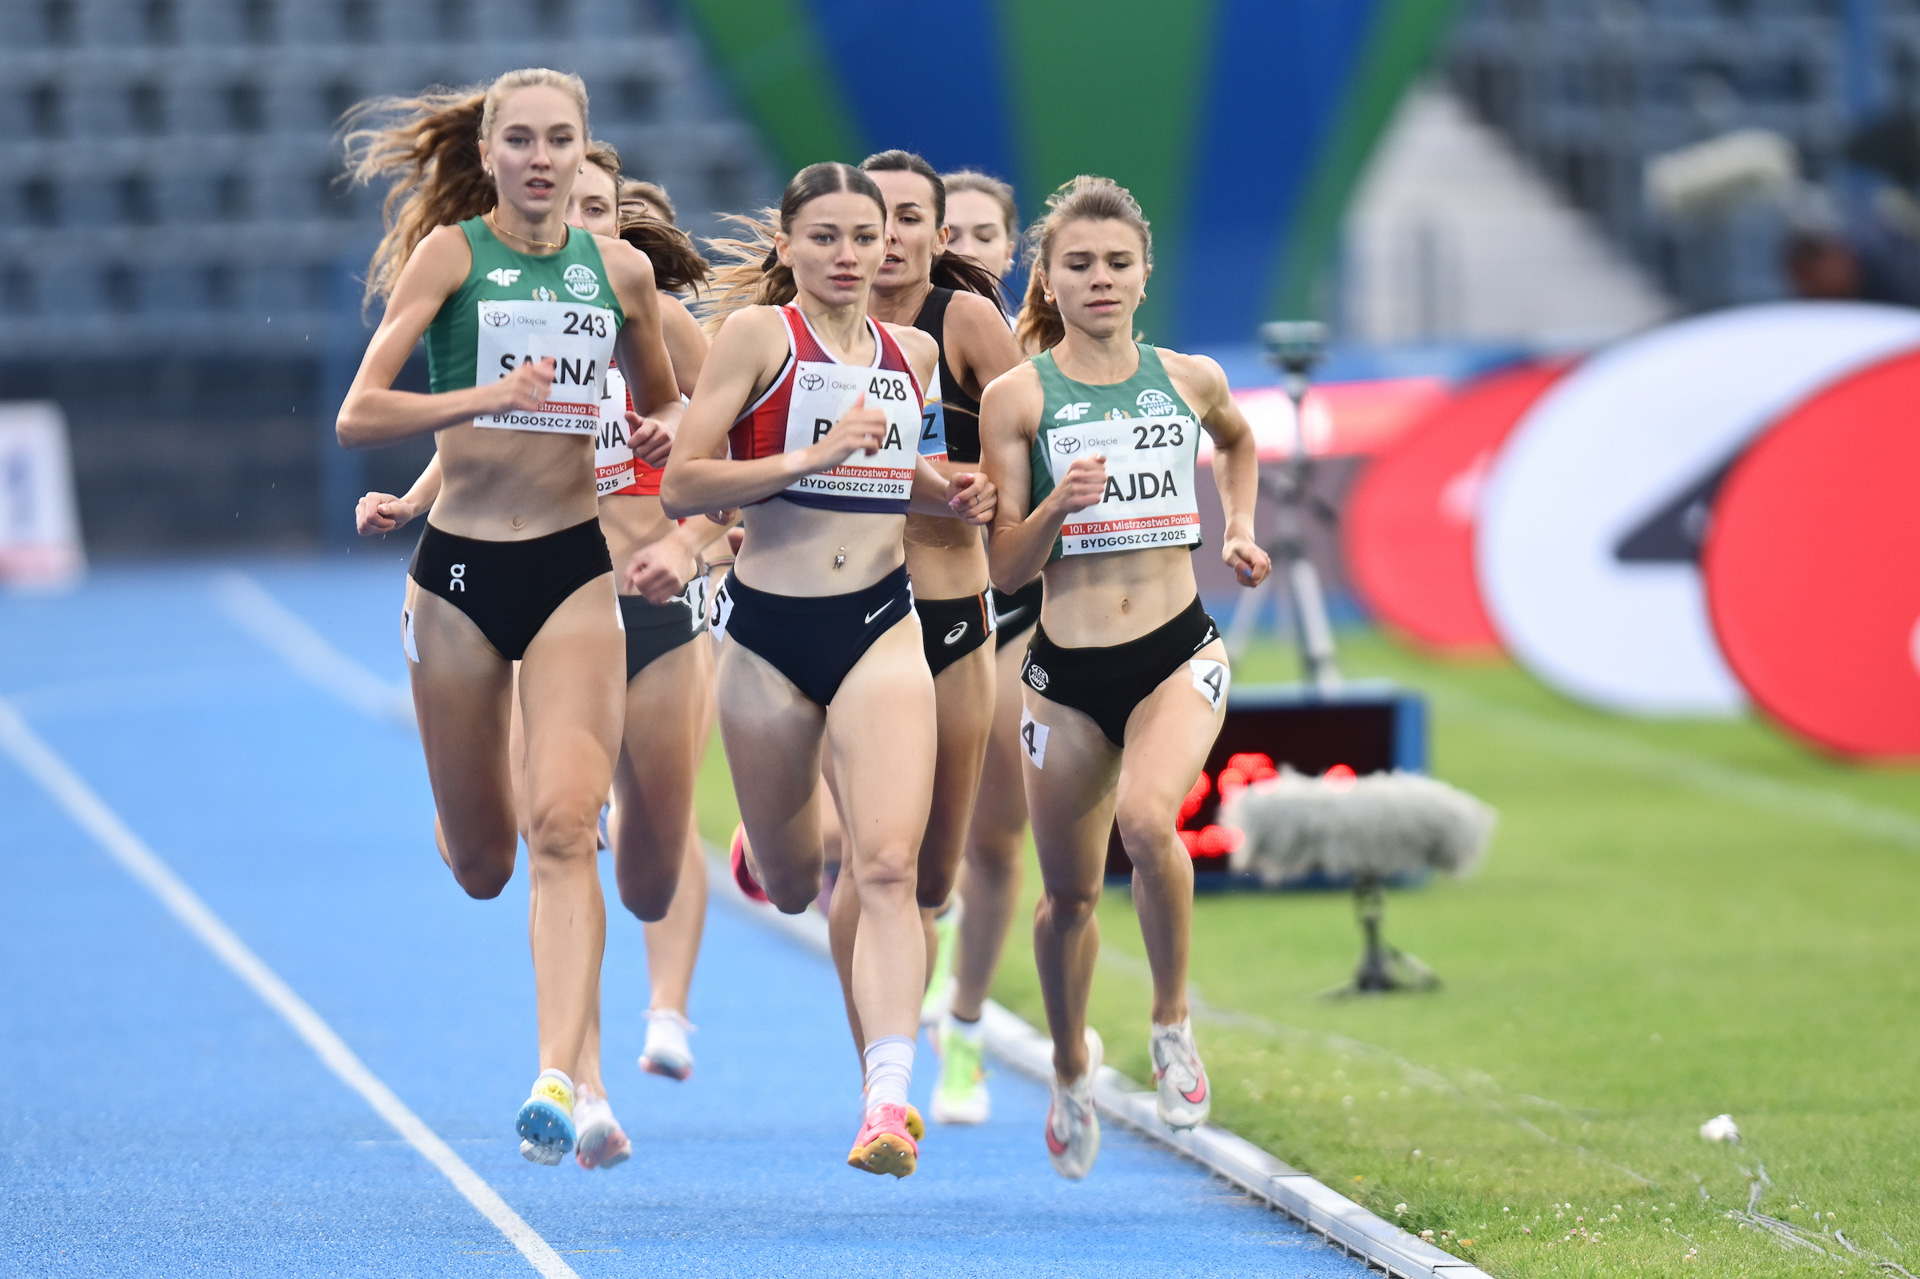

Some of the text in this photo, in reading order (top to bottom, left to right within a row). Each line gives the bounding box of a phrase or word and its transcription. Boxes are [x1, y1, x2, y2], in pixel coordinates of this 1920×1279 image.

[486, 268, 521, 287] 4F
[517, 316, 547, 327] Okęcie
[563, 311, 607, 338] 243
[499, 353, 596, 386] SNA
[831, 380, 857, 392] Okęcie
[868, 376, 907, 401] 428
[493, 414, 571, 428] BYDGOSZCZ
[1054, 402, 1091, 421] 4F
[1088, 438, 1118, 447] Okęcie
[1132, 423, 1184, 450] 223
[600, 463, 627, 477] Polski
[836, 466, 888, 478] Mistrzostwa
[890, 469, 912, 480] Polski
[800, 477, 905, 494] BYDGOSZCZ 2025
[1103, 470, 1177, 503] AJDA
[1069, 514, 1193, 534] 101. PZLA Mistrzostwa Polski
[1081, 530, 1187, 549] BYDGOSZCZ 2025
[1203, 664, 1223, 703] 4
[1022, 720, 1037, 757] 4
